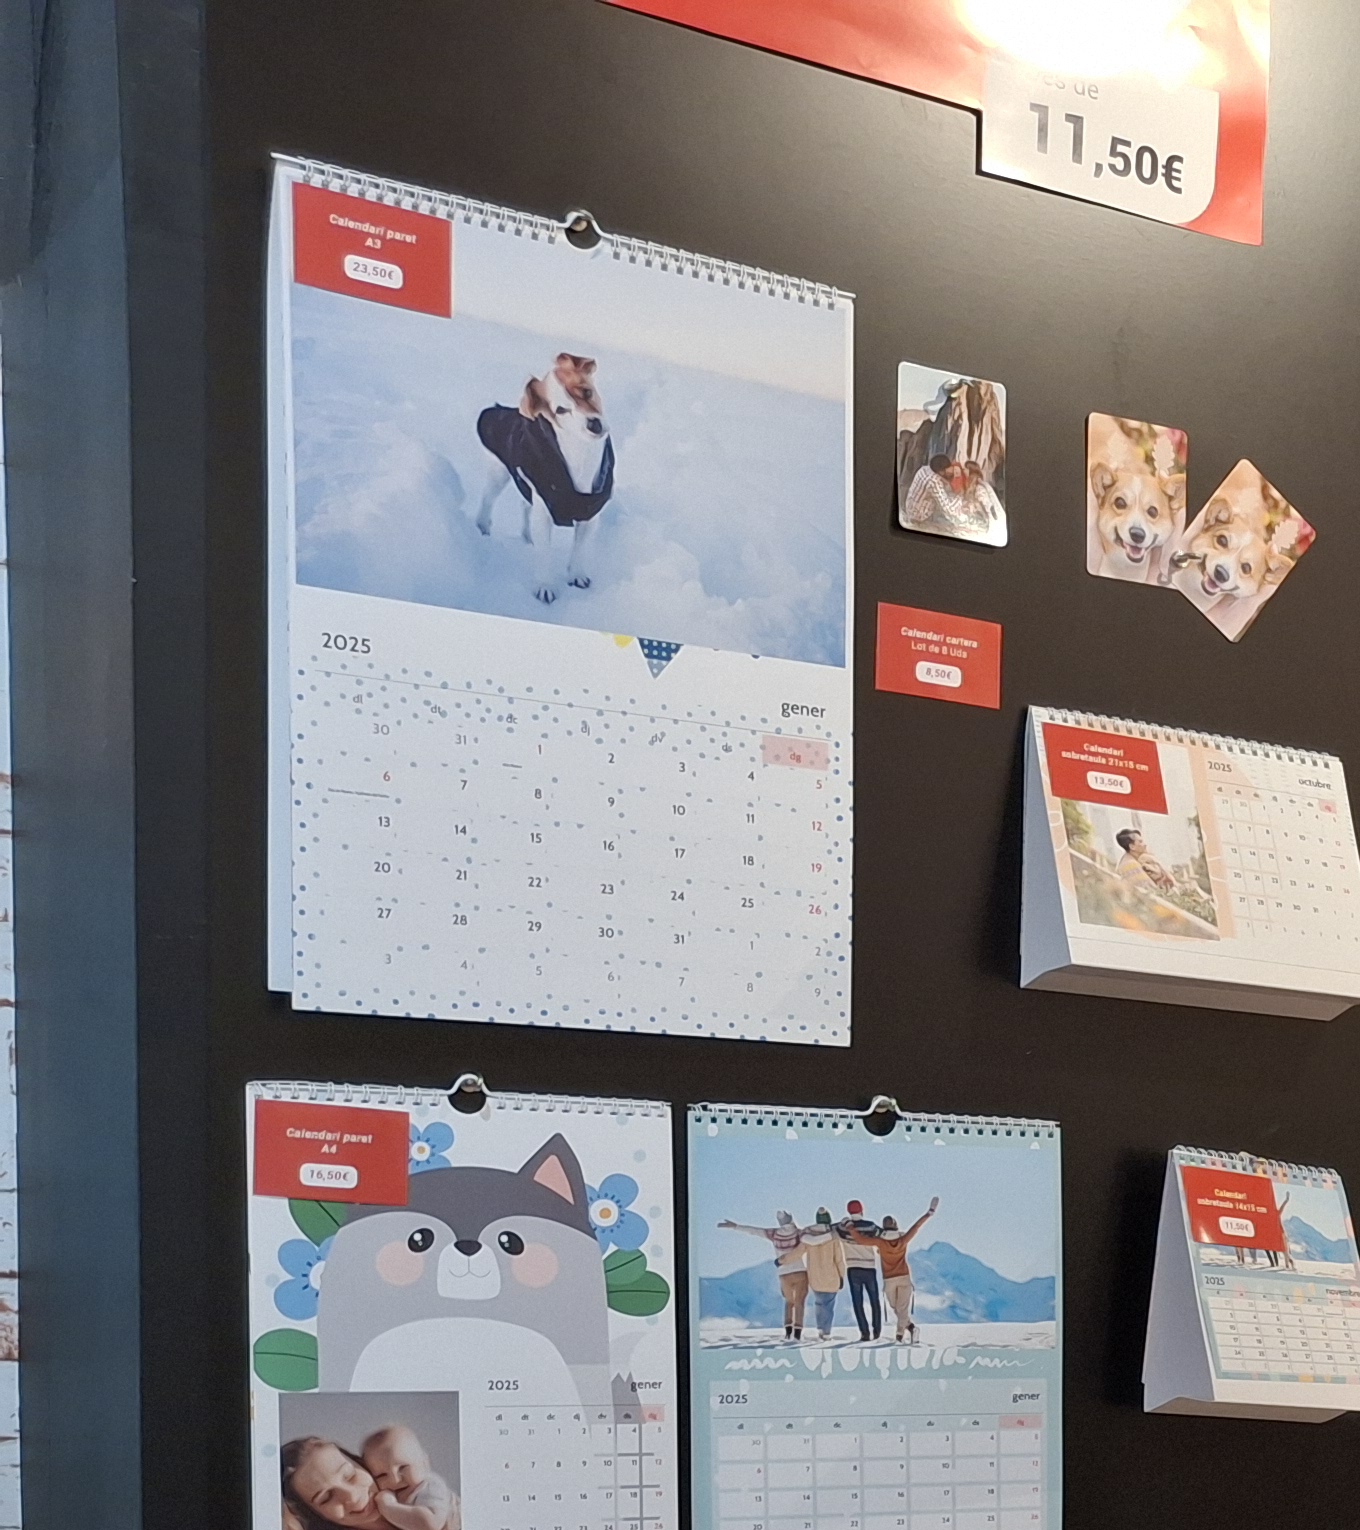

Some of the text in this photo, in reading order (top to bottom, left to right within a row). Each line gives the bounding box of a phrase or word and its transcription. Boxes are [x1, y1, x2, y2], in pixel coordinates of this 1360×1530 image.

[1029, 102, 1184, 194] 11,50€
[329, 213, 417, 244] Calendari paret
[365, 237, 382, 249] A3
[352, 261, 394, 280] 23,50€
[321, 632, 371, 654] 2025
[901, 626, 978, 648] Calendari cartera
[911, 640, 927, 651] Lot
[928, 643, 940, 654] de
[949, 647, 968, 658] Uds
[925, 667, 952, 680] 8,50€
[781, 701, 826, 719] gener
[373, 724, 390, 735] 30
[455, 735, 467, 745] 31
[608, 753, 615, 763] 2
[679, 762, 685, 772] 3
[748, 771, 754, 781] 4
[1083, 742, 1124, 757] Calendari
[1135, 763, 1149, 772] cm
[1208, 761, 1233, 773] 2025
[1093, 776, 1124, 789] 13,50€
[1298, 778, 1332, 791] octubre
[383, 771, 822, 831] 6 7 8 9 10 11 12
[379, 817, 822, 873] 13 14 15 16 17 18 19
[374, 862, 822, 915] 20 21 22 23 24 25 26
[378, 908, 391, 919] 27
[452, 915, 468, 926] 28
[528, 921, 542, 932] 29
[598, 927, 614, 938] 30
[674, 934, 685, 944] 31
[814, 946, 821, 956] 2
[286, 1127, 373, 1145] Calendari paret
[320, 1143, 337, 1154] A4
[309, 1169, 350, 1182] 16,50€
[1204, 1276, 1226, 1287] 2025
[1325, 1288, 1360, 1299] novembre
[488, 1380, 519, 1391] 2025
[630, 1379, 662, 1393] gener
[718, 1393, 748, 1405] 2025
[1012, 1391, 1041, 1403] gener
